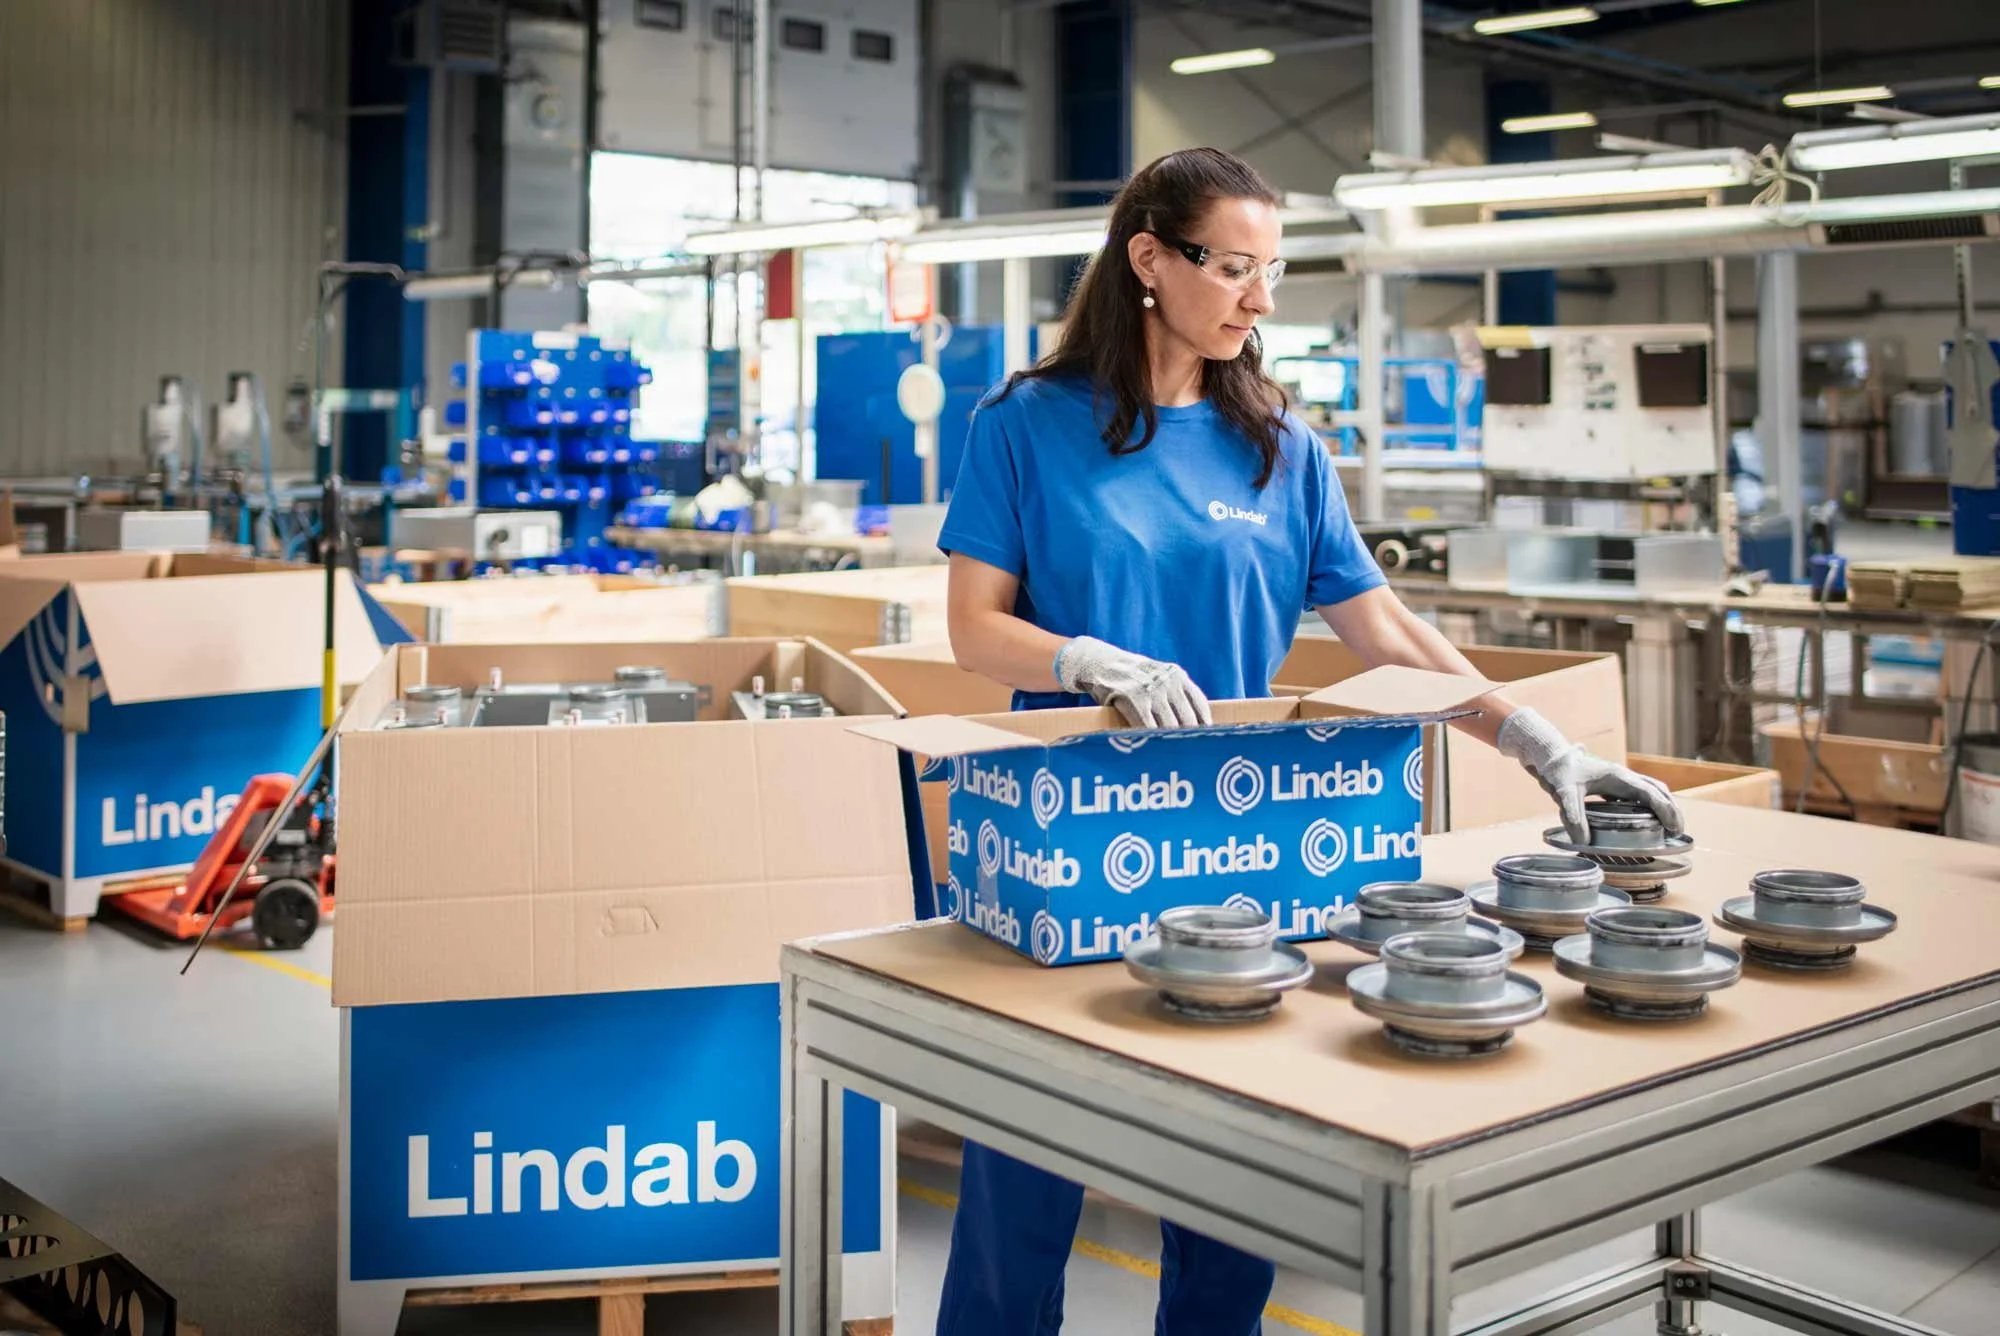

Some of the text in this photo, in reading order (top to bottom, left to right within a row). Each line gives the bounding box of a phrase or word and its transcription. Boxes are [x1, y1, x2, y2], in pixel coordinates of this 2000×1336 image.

[963, 756, 1021, 808] Lindab
[1071, 771, 1194, 815] Lindab
[1271, 760, 1384, 801] Lindab
[102, 785, 241, 846] Linda
[1004, 837, 1081, 889] Lindab
[1161, 834, 1280, 878] Lindab
[1354, 822, 1422, 862] Lind
[965, 888, 1021, 947] Lindab
[1072, 912, 1158, 957] Lind
[408, 1120, 758, 1218] Lindab
